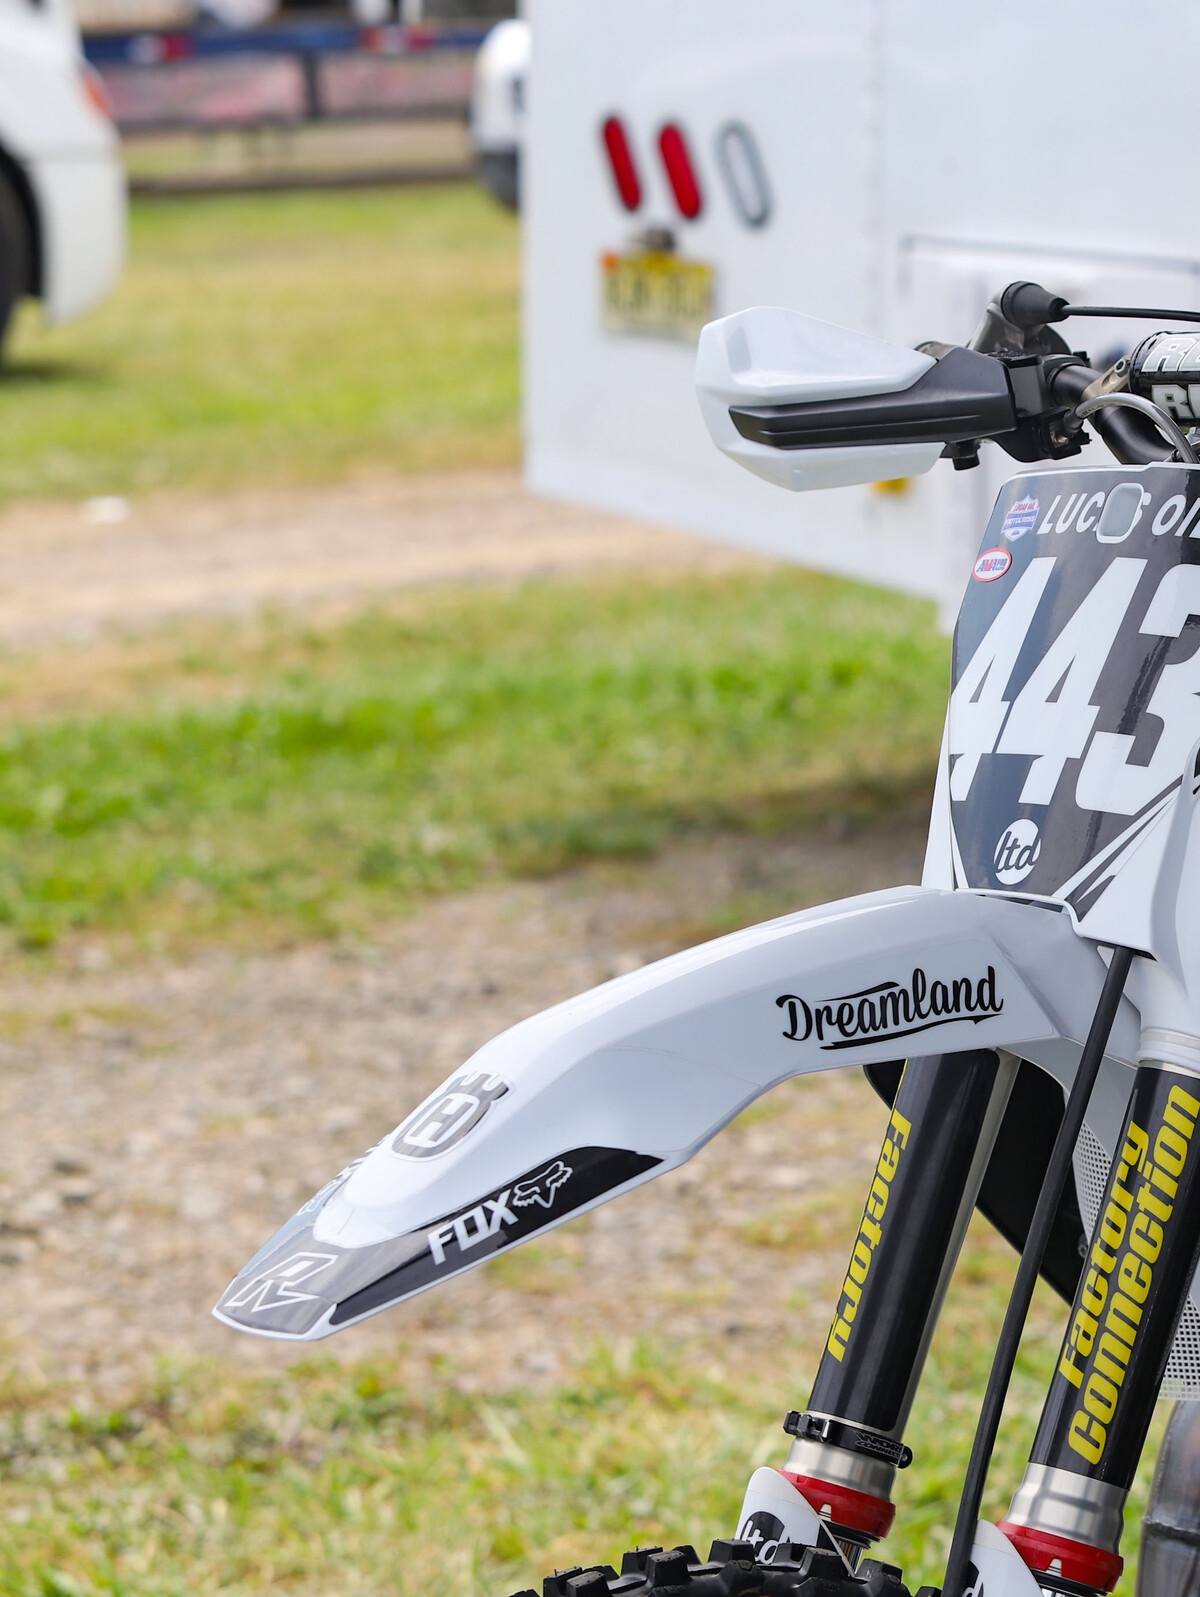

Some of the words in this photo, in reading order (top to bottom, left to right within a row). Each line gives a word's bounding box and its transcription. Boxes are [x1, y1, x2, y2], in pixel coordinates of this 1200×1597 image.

[993, 828, 1041, 873] ltd
[776, 966, 1003, 1041] Dreamland
[428, 1190, 519, 1265] FOX
[1059, 1120, 1149, 1389] Factory
